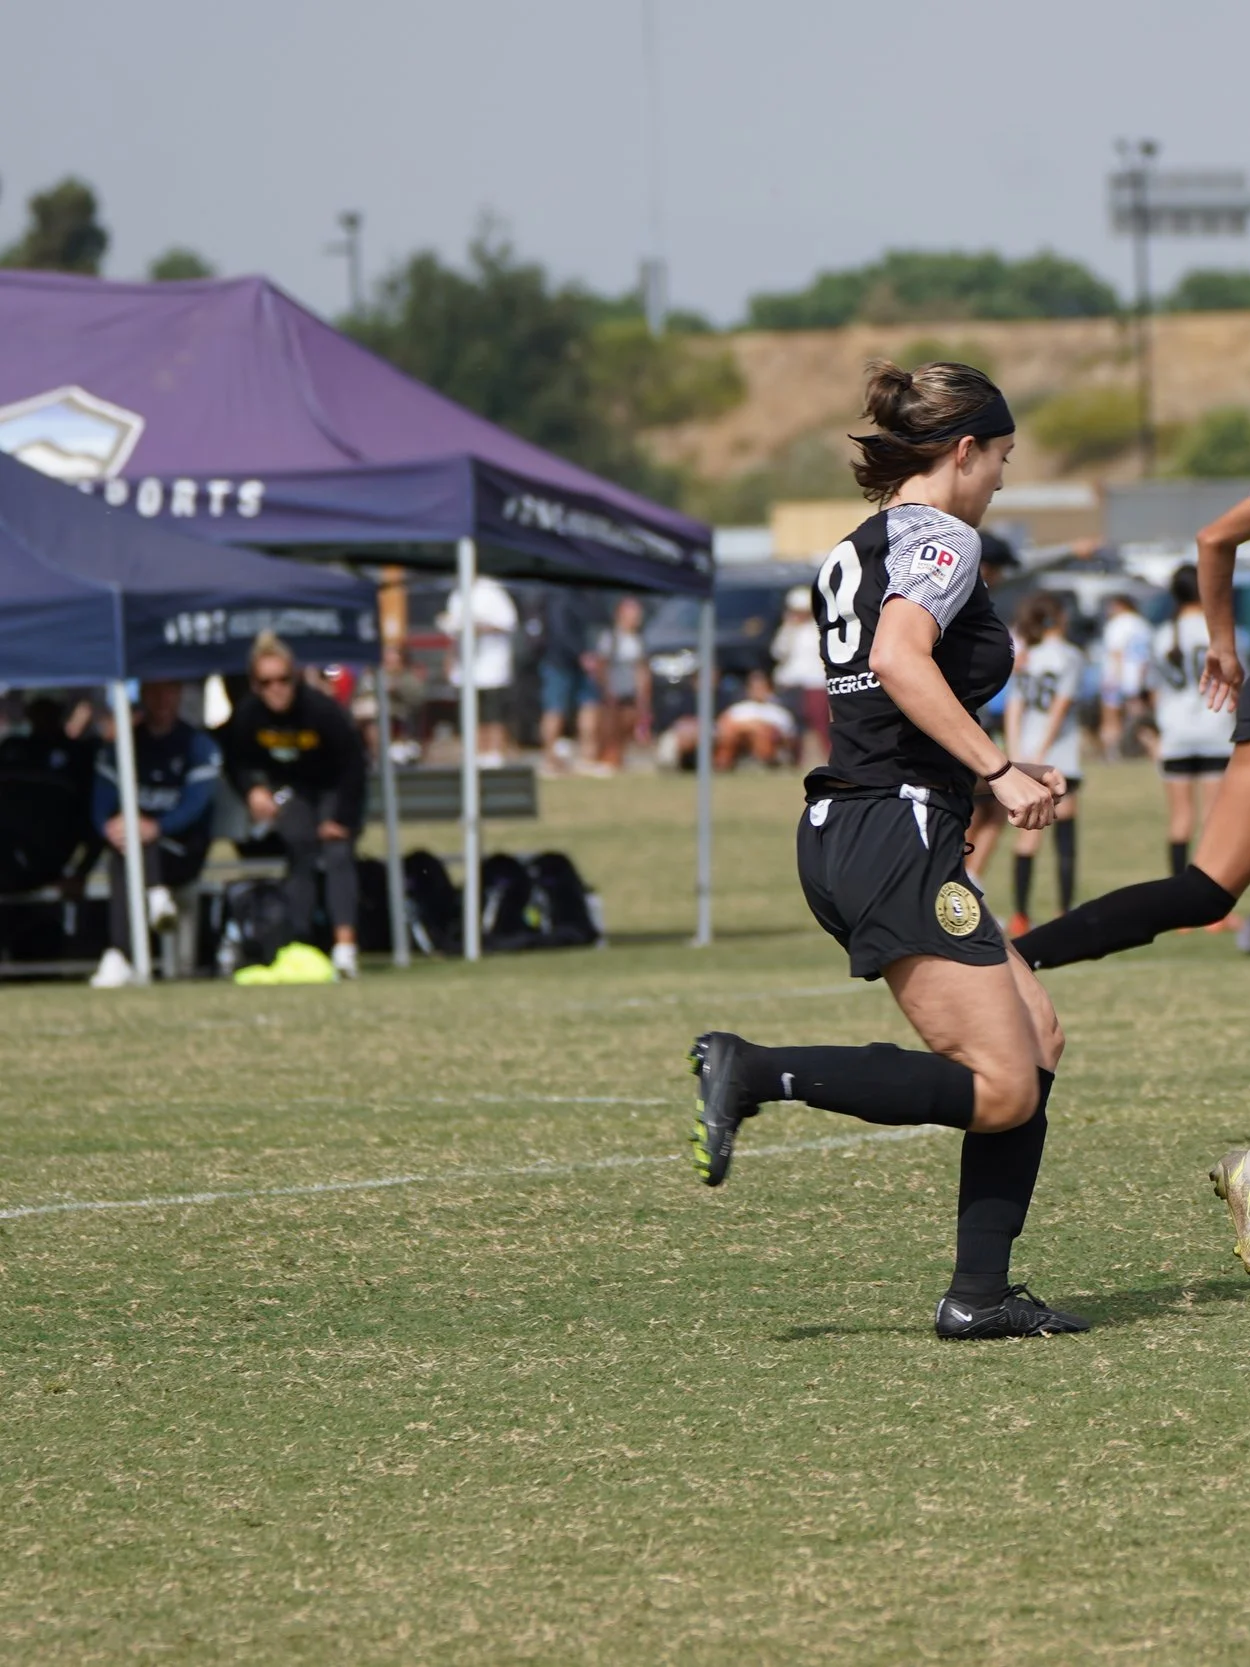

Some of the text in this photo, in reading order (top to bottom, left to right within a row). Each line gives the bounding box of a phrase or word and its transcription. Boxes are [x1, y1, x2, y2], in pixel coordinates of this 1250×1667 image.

[77, 477, 265, 517] PORTS
[920, 545, 954, 567] DP
[818, 540, 862, 664] 9
